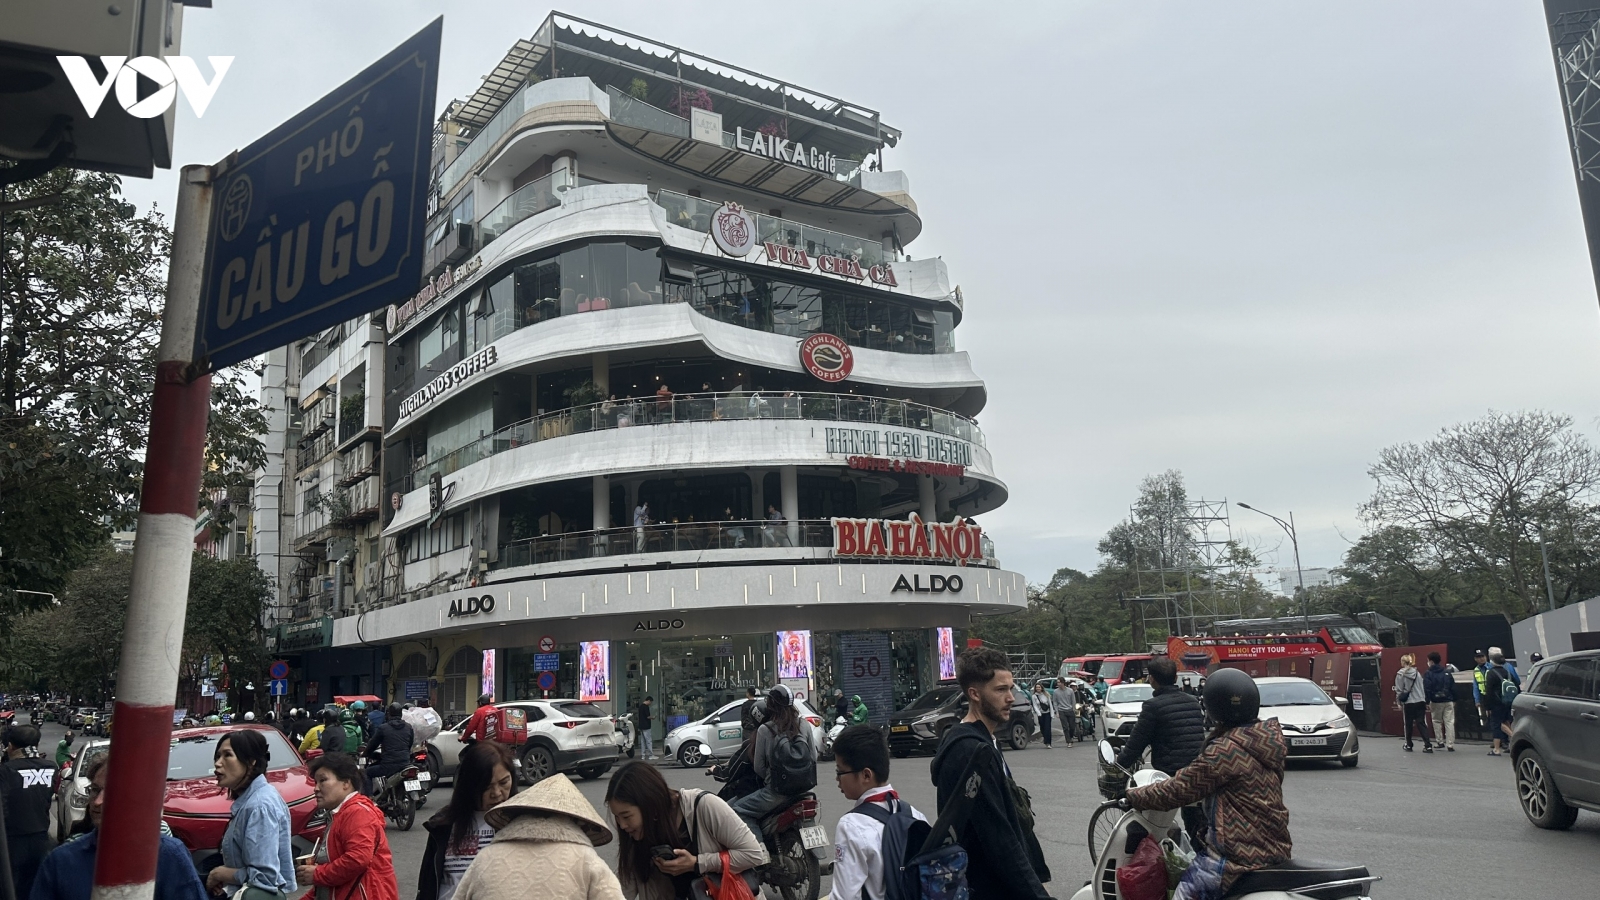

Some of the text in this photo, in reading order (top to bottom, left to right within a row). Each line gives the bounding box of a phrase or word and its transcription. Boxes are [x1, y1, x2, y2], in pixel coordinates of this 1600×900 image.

[294, 91, 370, 187] PHỐ
[736, 126, 836, 173] LAIKA Café
[216, 141, 396, 331] CẦU GỖ
[763, 241, 899, 287] VUA CHẢ CÁ
[804, 336, 851, 359] HIGHLANDS
[399, 346, 495, 419] HIGHLANDS COFFEE
[811, 366, 846, 380] COFFEE
[885, 430, 923, 459] 1930
[847, 455, 891, 472] COFFEE
[832, 512, 984, 567] BIA HÀ NỘI
[891, 574, 964, 593] ALDO
[448, 594, 496, 618] ALDO
[633, 618, 685, 631] ALDO
[853, 656, 881, 678] 50
